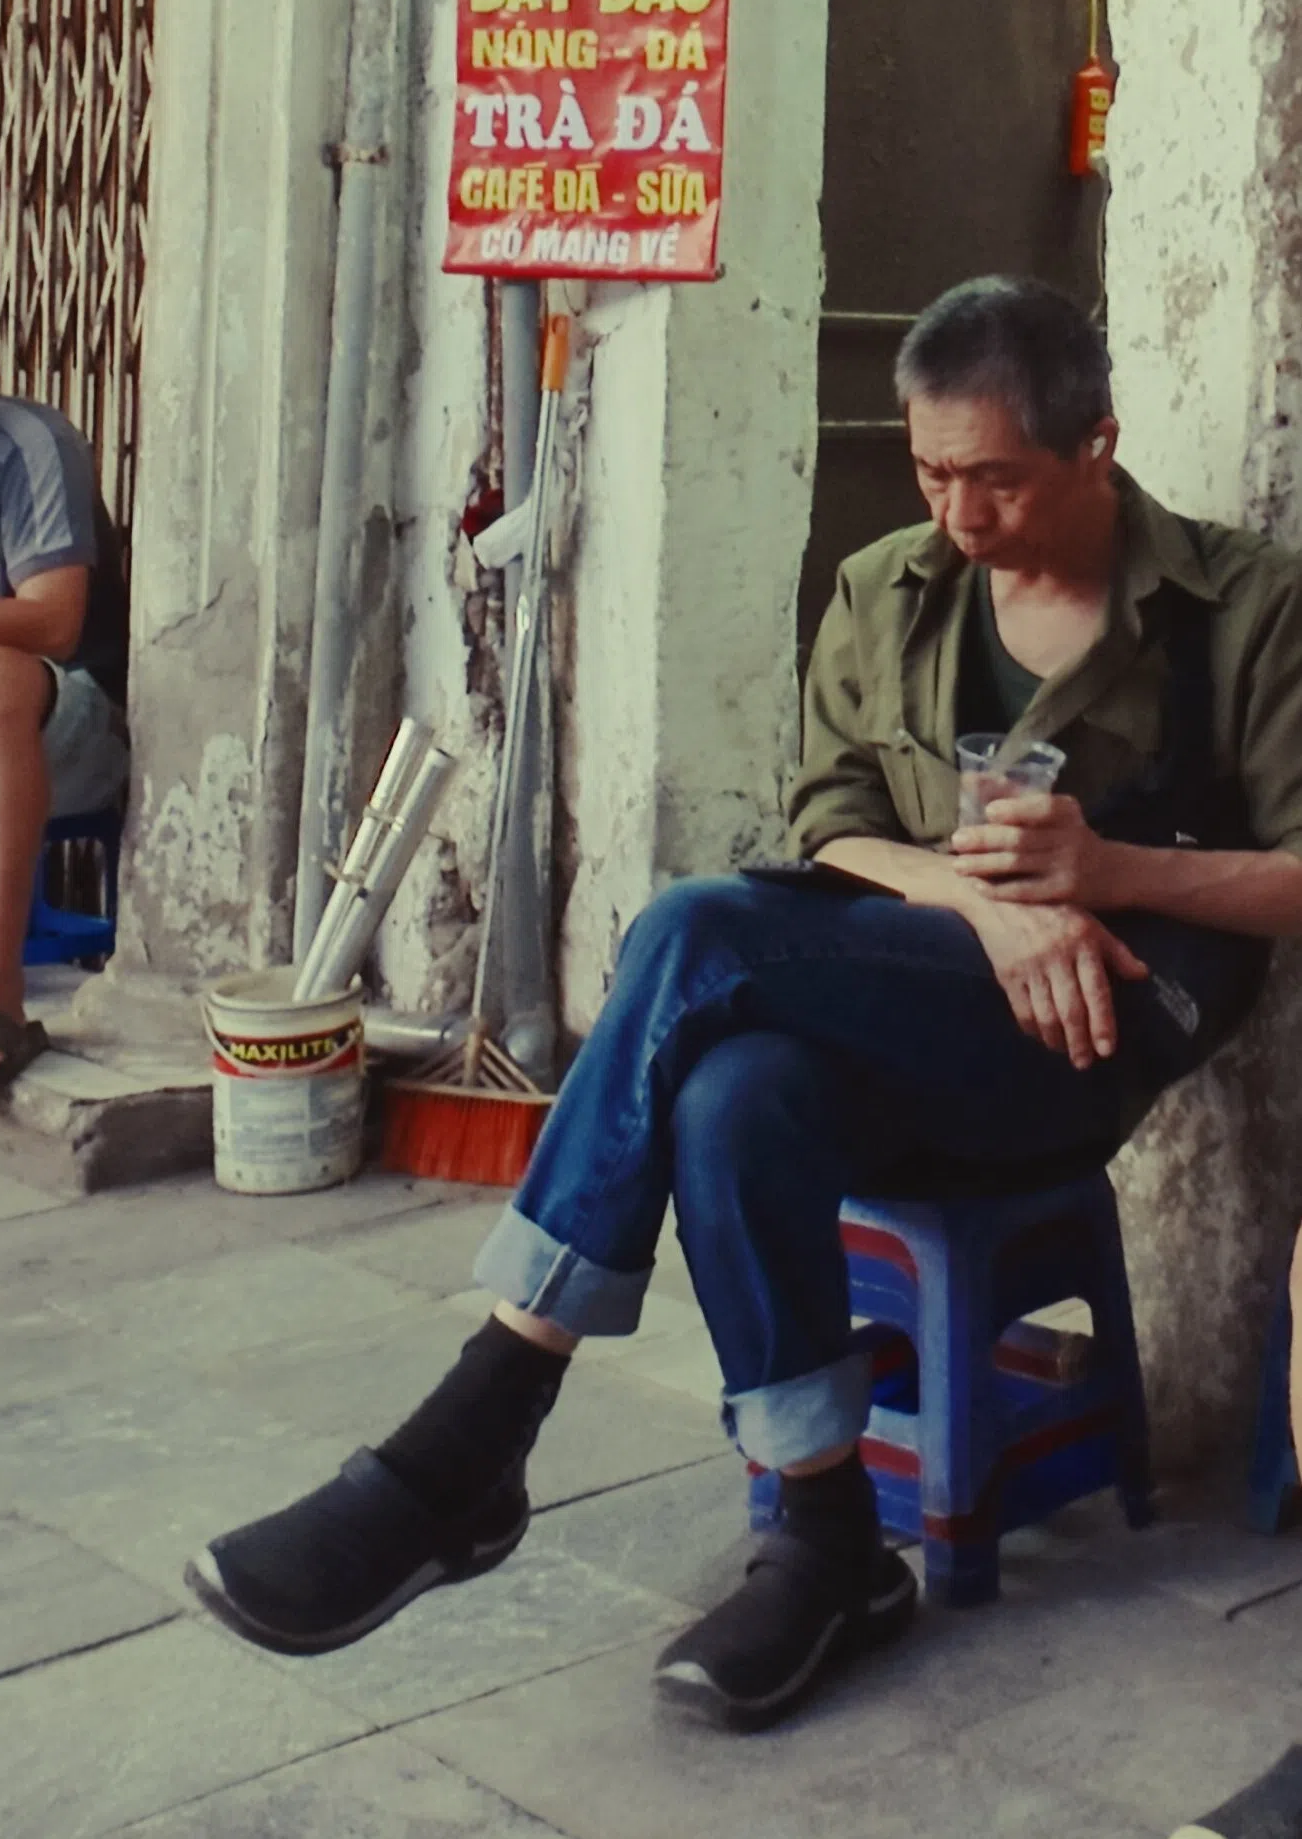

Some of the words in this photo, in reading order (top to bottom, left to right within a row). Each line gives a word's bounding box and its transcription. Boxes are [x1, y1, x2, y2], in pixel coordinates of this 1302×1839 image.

[471, 20, 598, 70] NÓNG
[644, 20, 708, 71] ĐÁ
[463, 77, 594, 150] TRÀ
[612, 79, 712, 152] ĐÁ
[636, 162, 706, 215] SỮA
[530, 228, 630, 266] MANG
